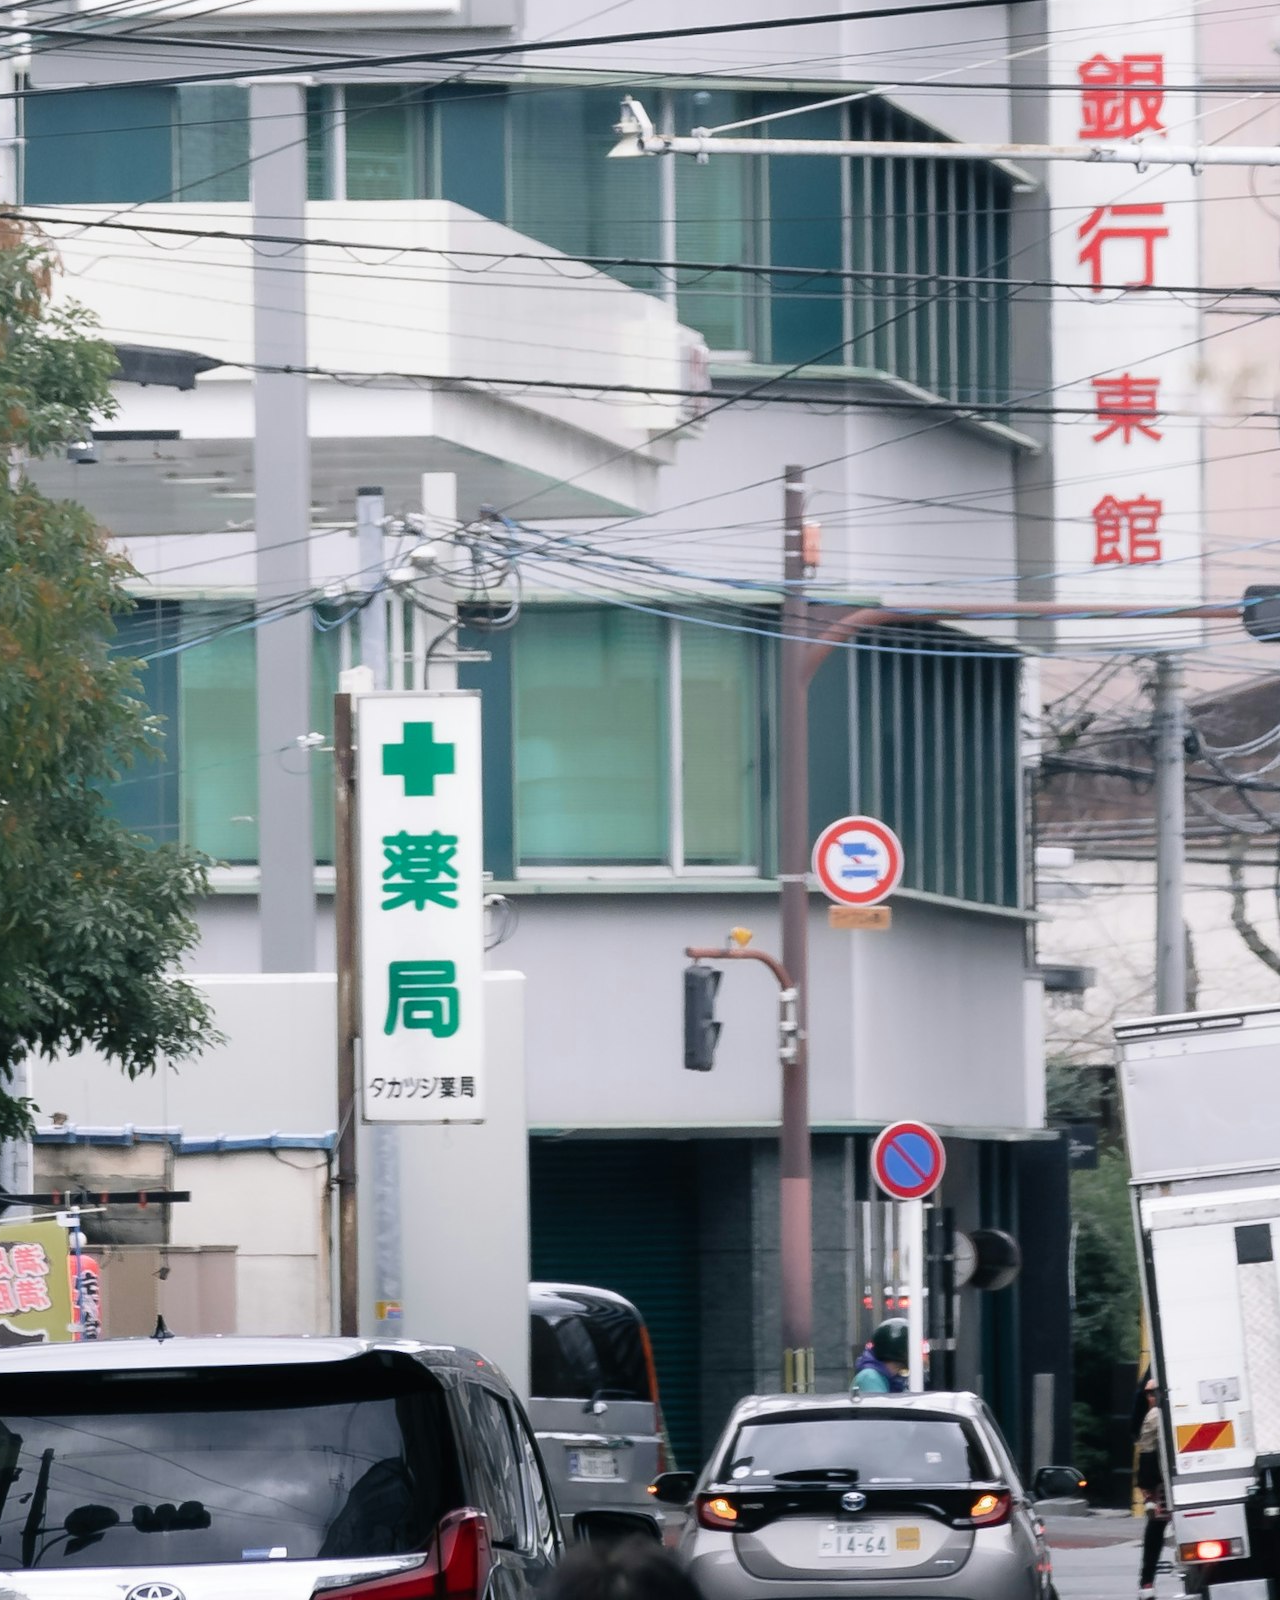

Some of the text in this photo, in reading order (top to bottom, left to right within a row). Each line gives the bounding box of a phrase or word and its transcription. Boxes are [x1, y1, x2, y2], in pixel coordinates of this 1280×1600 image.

[1091, 373, 1163, 565] 東館
[381, 829, 460, 1039] 薬局
[369, 1076, 475, 1099] タカツジ薬局
[836, 1535, 886, 1554] 14-64
